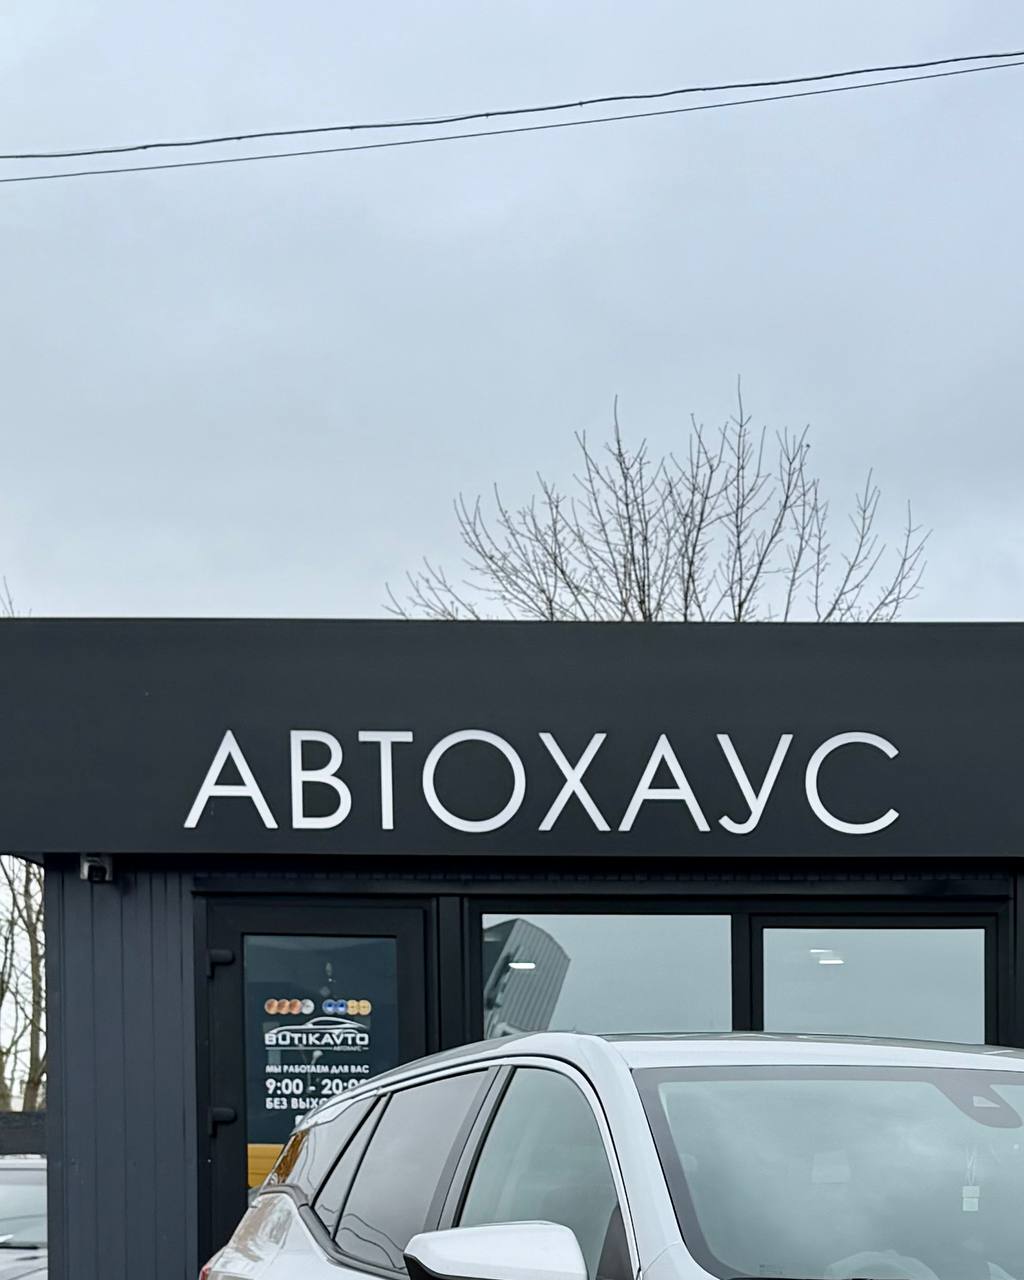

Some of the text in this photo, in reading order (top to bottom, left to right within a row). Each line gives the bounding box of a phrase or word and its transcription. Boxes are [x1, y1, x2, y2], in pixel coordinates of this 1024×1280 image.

[183, 728, 900, 835] АВТОХАУС
[265, 1033, 369, 1045] BUTIKAVTO
[265, 1065, 369, 1074] МЫ РАБОТАЕМ ДЛЯ ВАС
[265, 1078, 304, 1095] 9:00
[321, 1078, 367, 1095] 20:0
[265, 1097, 288, 1109] БЕЗ
